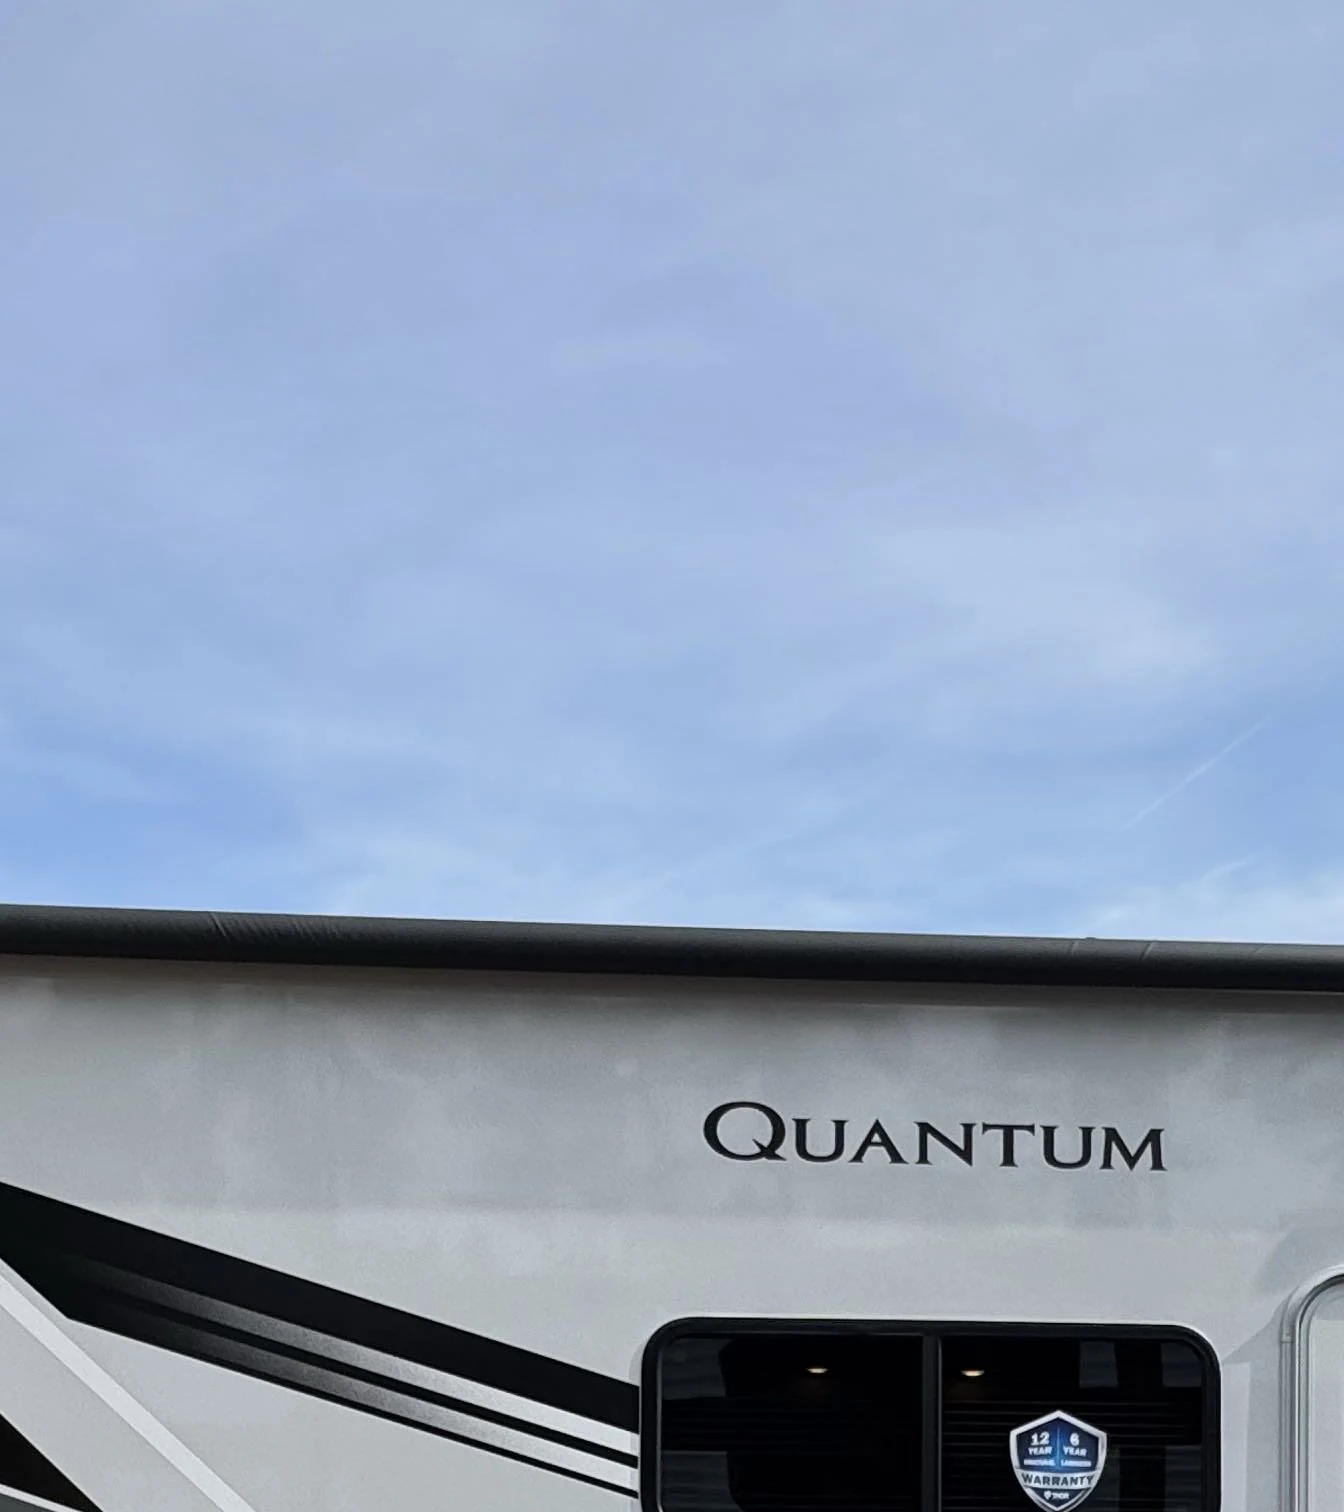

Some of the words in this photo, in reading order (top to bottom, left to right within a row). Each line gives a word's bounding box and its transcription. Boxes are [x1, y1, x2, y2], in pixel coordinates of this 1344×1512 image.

[702, 1100, 1167, 1172] QUANTUM
[1031, 1431, 1050, 1446] 12
[1070, 1433, 1080, 1446] 6
[1028, 1446, 1053, 1455] YEAR
[1063, 1446, 1087, 1457] YEAR
[1021, 1473, 1094, 1486] WARRANTY
